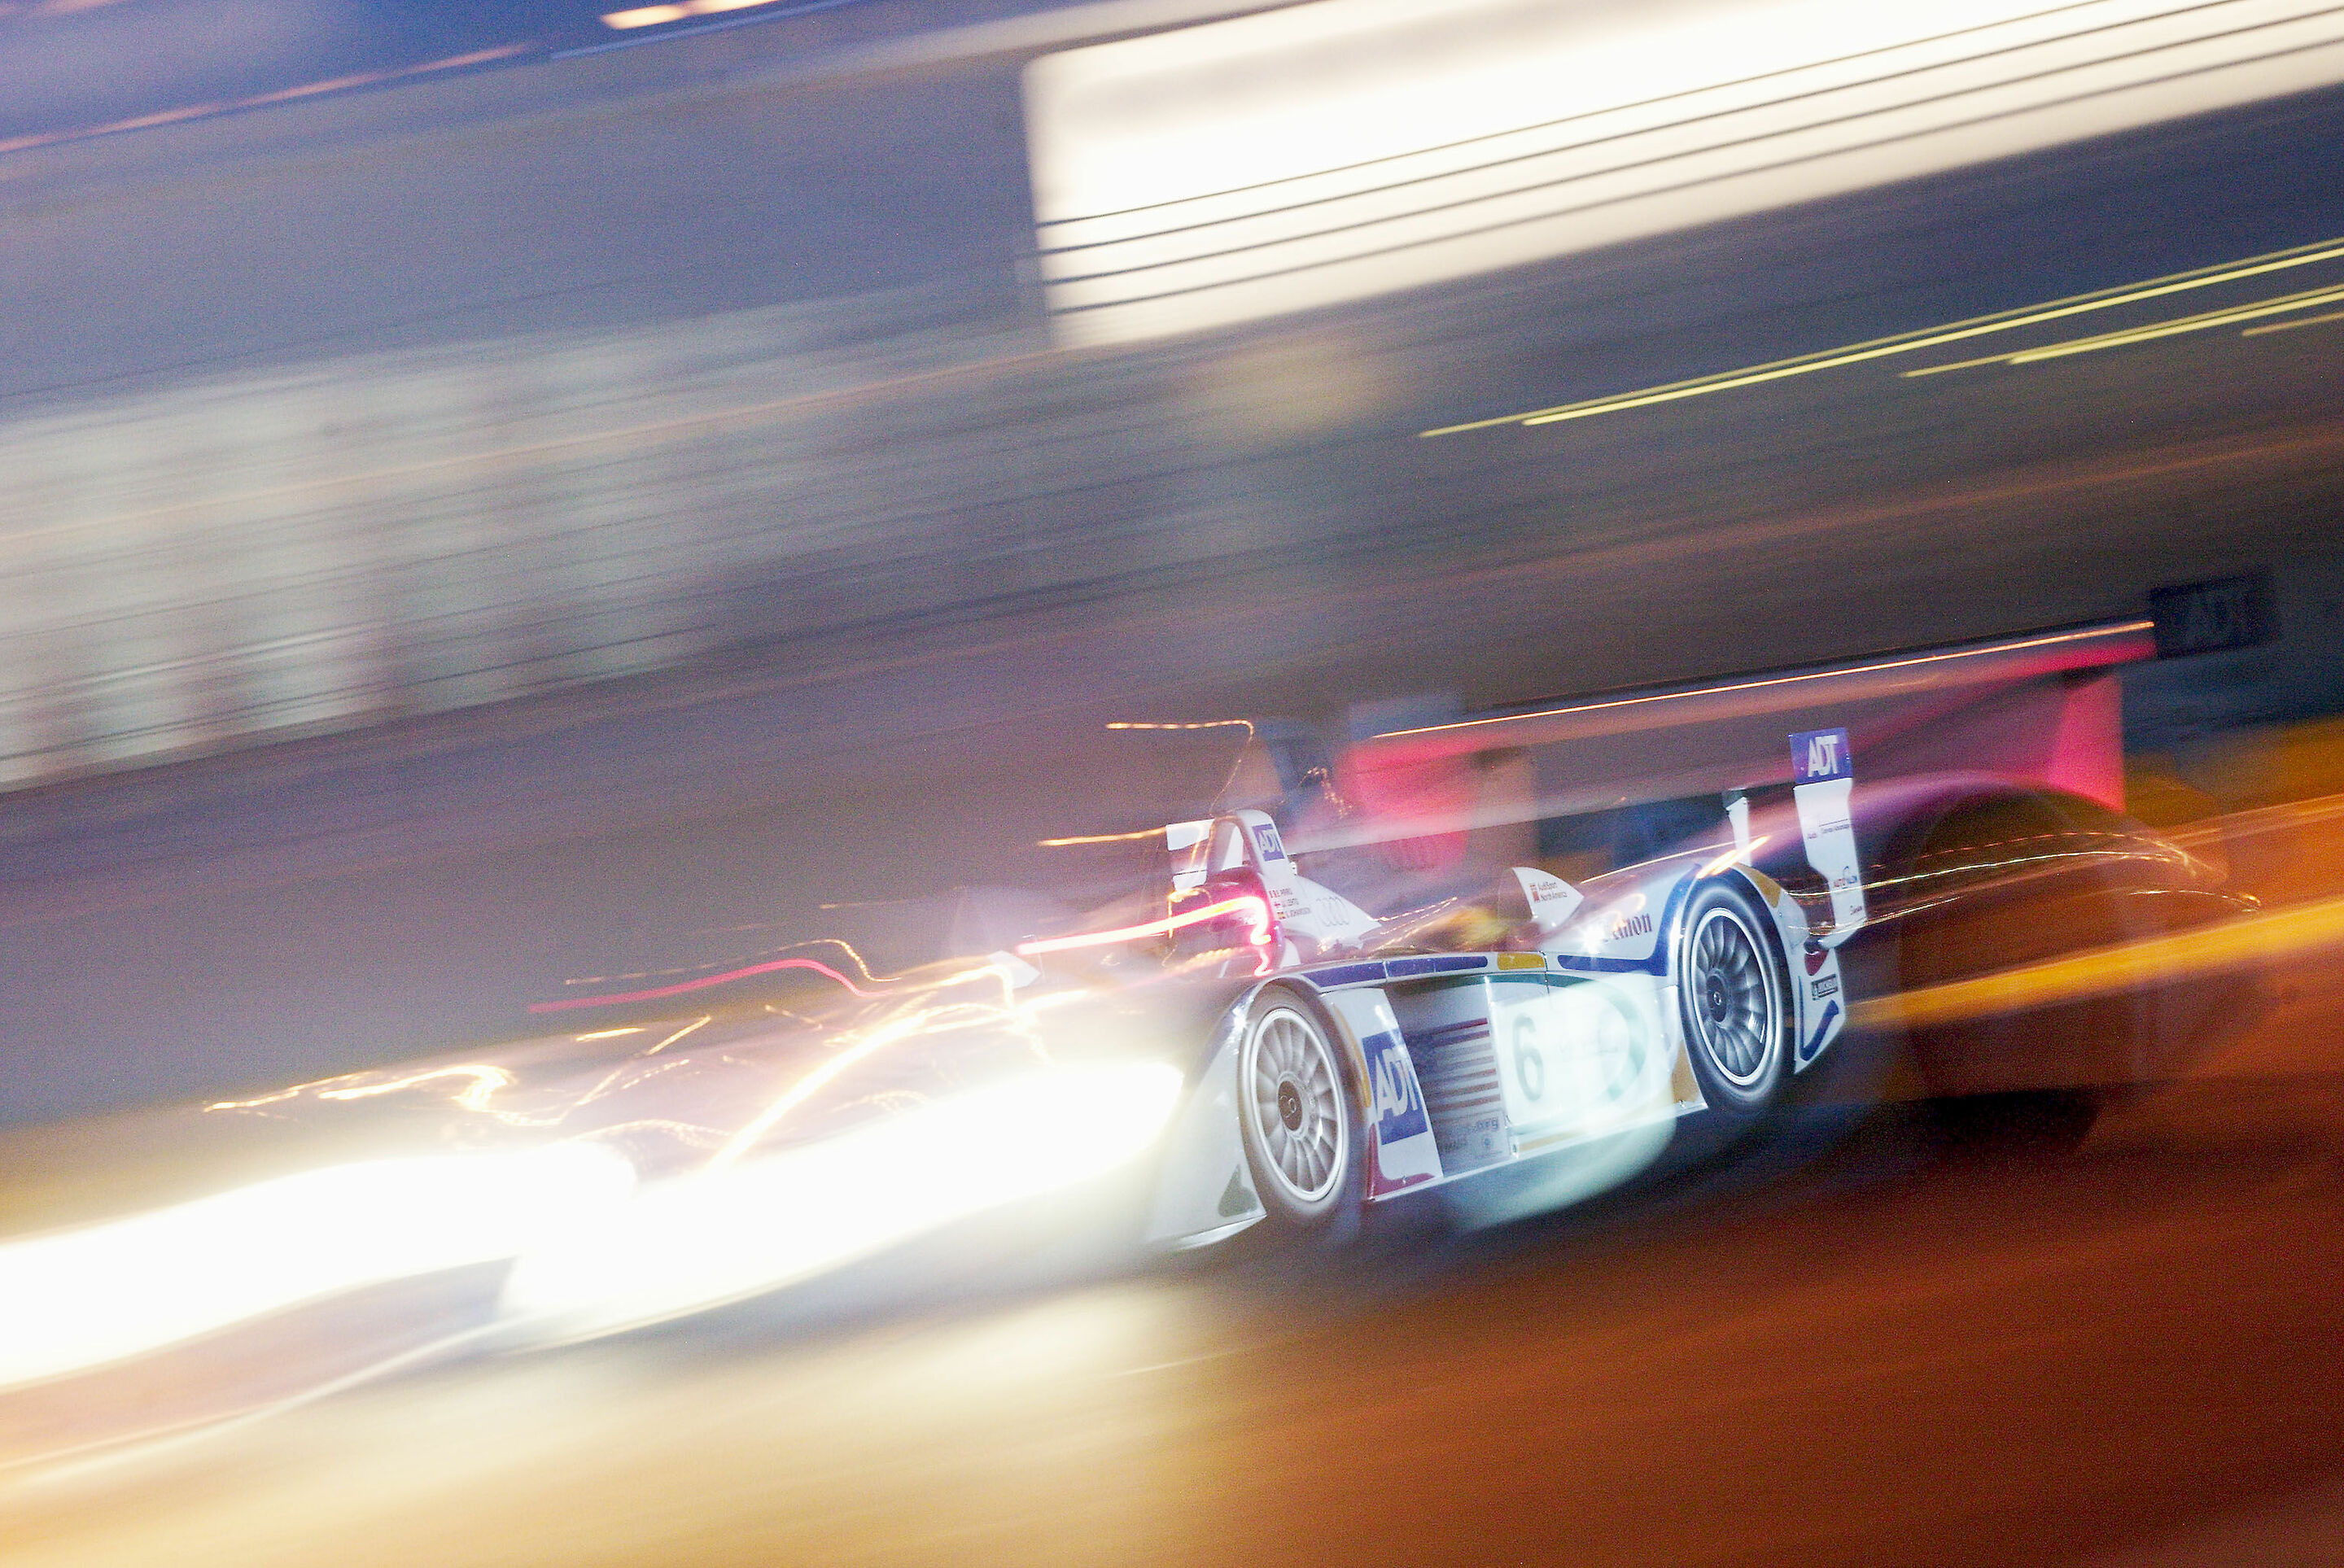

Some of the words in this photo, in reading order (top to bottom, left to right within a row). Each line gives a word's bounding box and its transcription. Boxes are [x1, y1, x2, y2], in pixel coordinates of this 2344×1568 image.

[1807, 735, 1840, 778] ADT
[1258, 829, 1281, 854] ADT
[1375, 1046, 1418, 1122] ADT
[1513, 1014, 1544, 1101] 6
